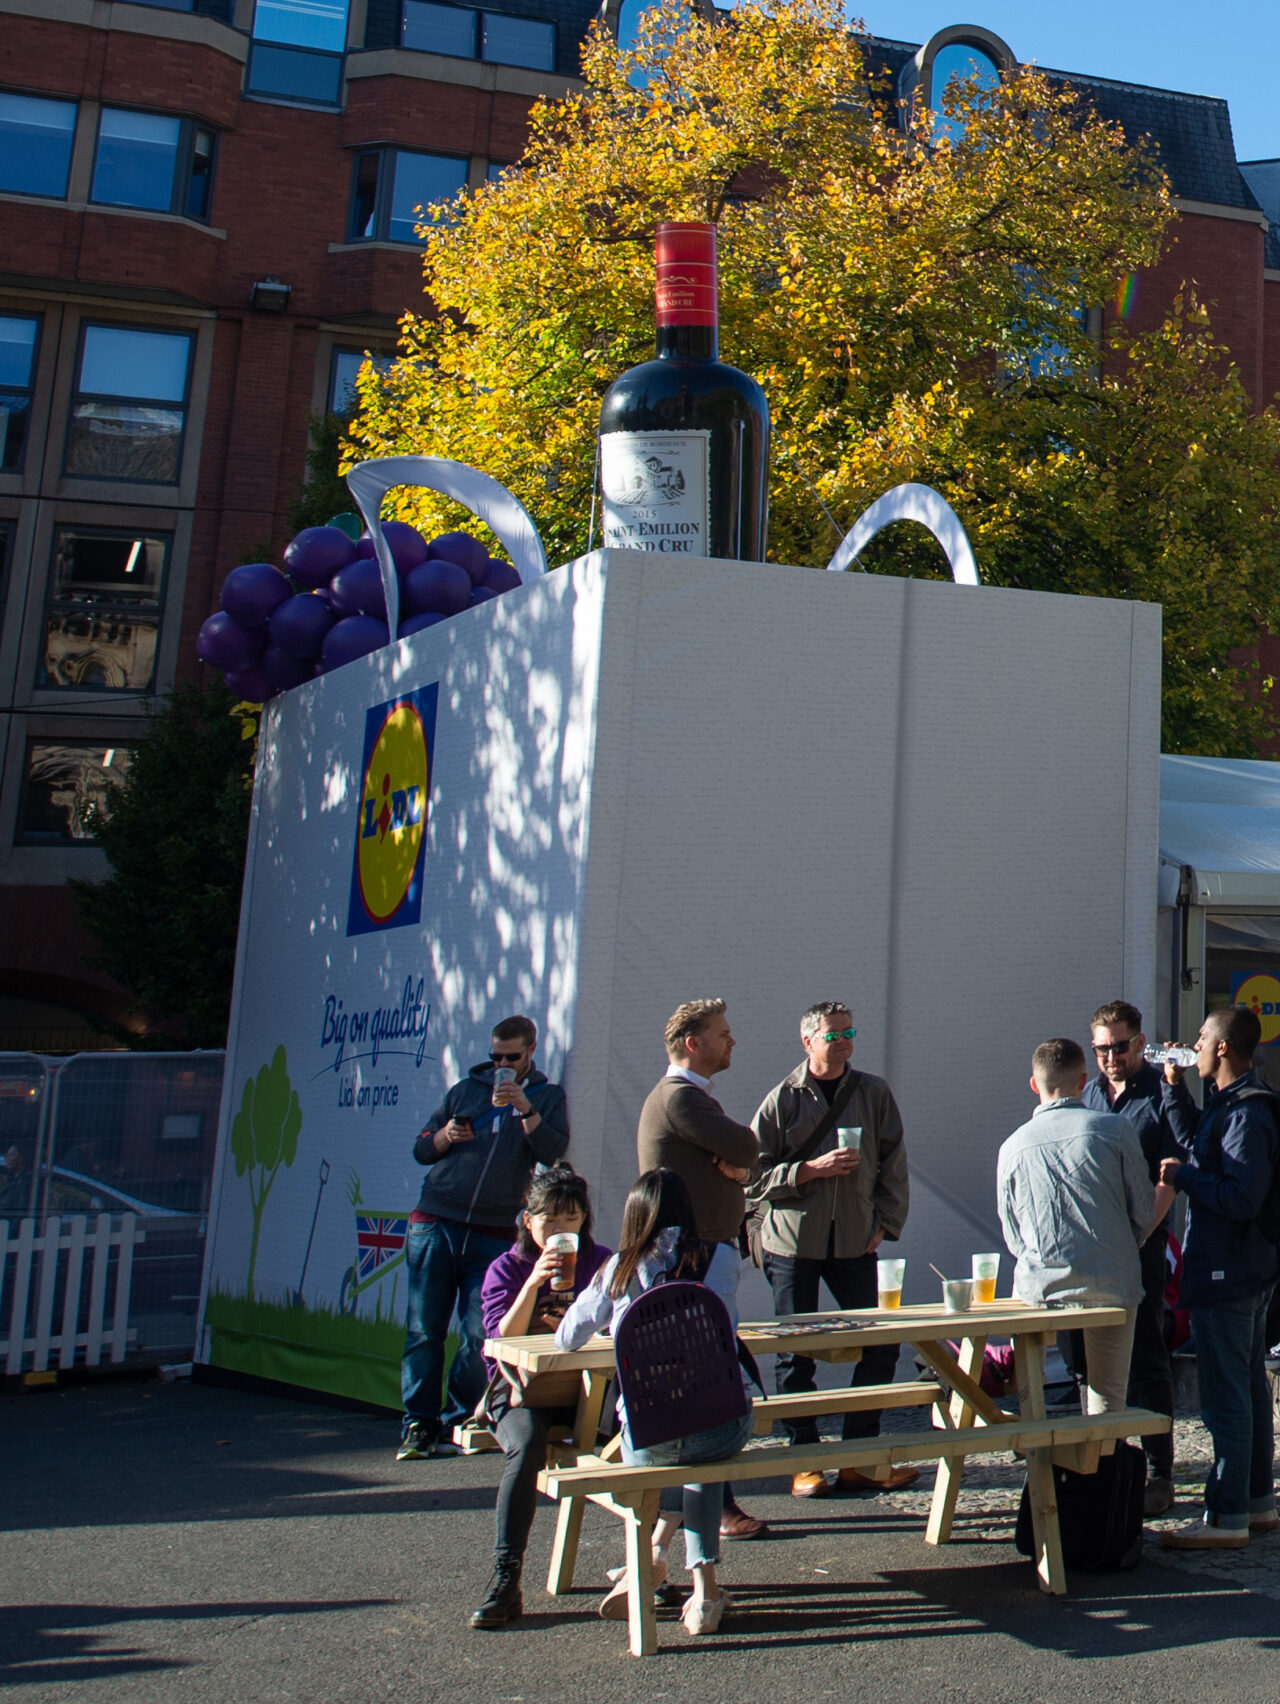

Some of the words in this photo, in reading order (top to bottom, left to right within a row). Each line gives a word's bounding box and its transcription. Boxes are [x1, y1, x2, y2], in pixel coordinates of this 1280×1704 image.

[632, 510, 657, 520] 2015
[658, 538, 693, 553] CRU
[320, 994, 348, 1072] Big
[350, 1011, 369, 1043] on
[371, 975, 431, 1068] quality
[338, 1075, 359, 1108] Lidl
[358, 1086, 371, 1107] on
[371, 1075, 399, 1117] price
